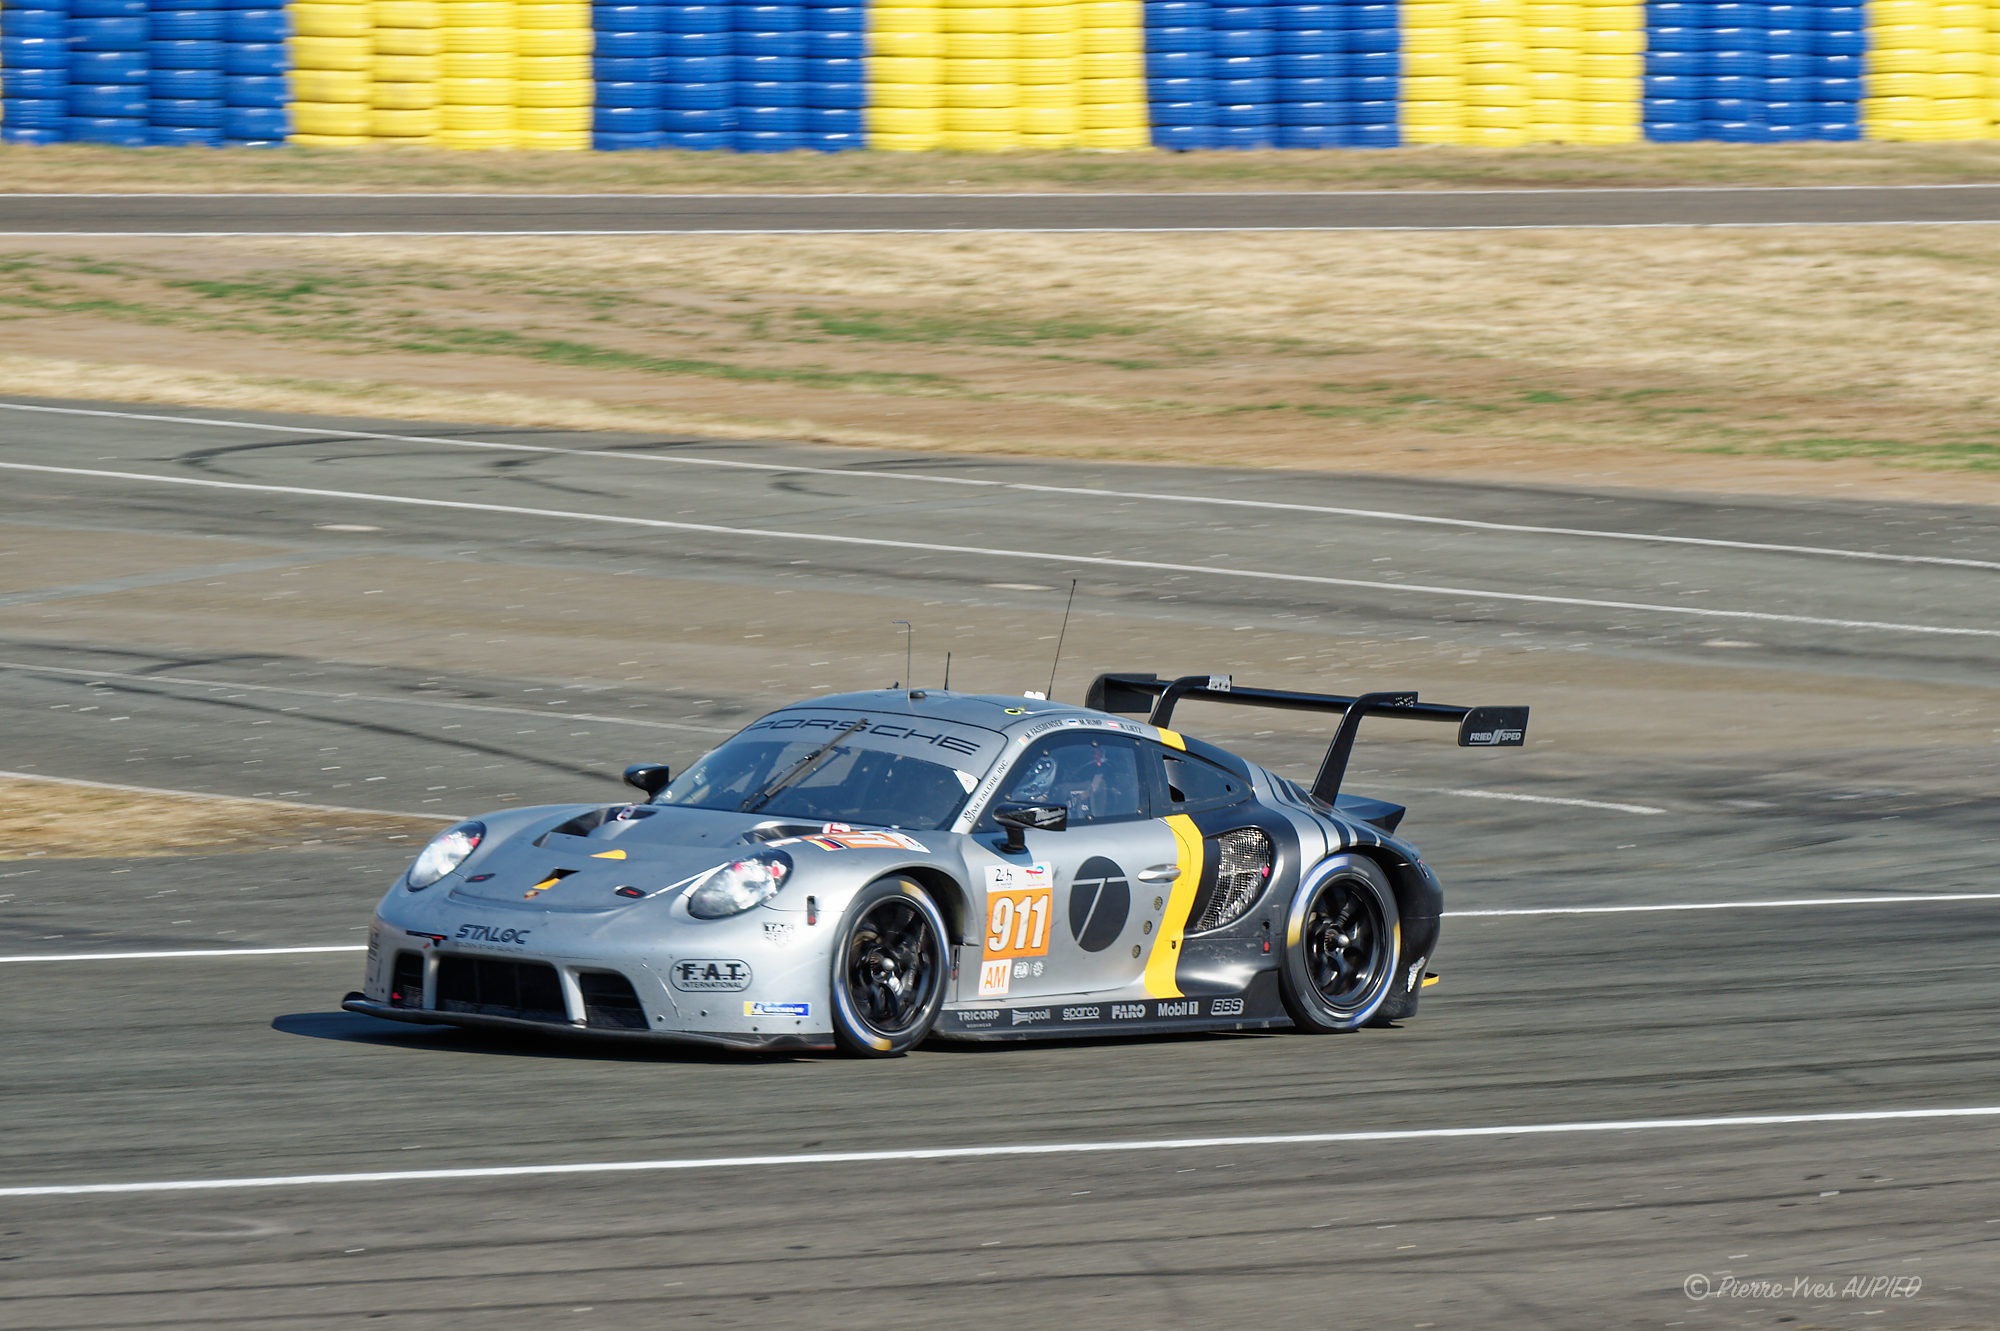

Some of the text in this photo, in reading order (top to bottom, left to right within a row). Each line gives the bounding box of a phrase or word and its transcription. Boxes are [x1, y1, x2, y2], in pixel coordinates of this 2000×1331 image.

[750, 718, 981, 756] PORSCHE
[988, 894, 1049, 952] 911
[455, 923, 531, 945] STALOC
[984, 965, 1006, 989] AM
[957, 1010, 1000, 1021] TRICORP
[1062, 1007, 1100, 1020] sparco
[1111, 1004, 1146, 1020] FARO
[1157, 1002, 1187, 1017] Mobil
[1210, 998, 1244, 1016] BBS
